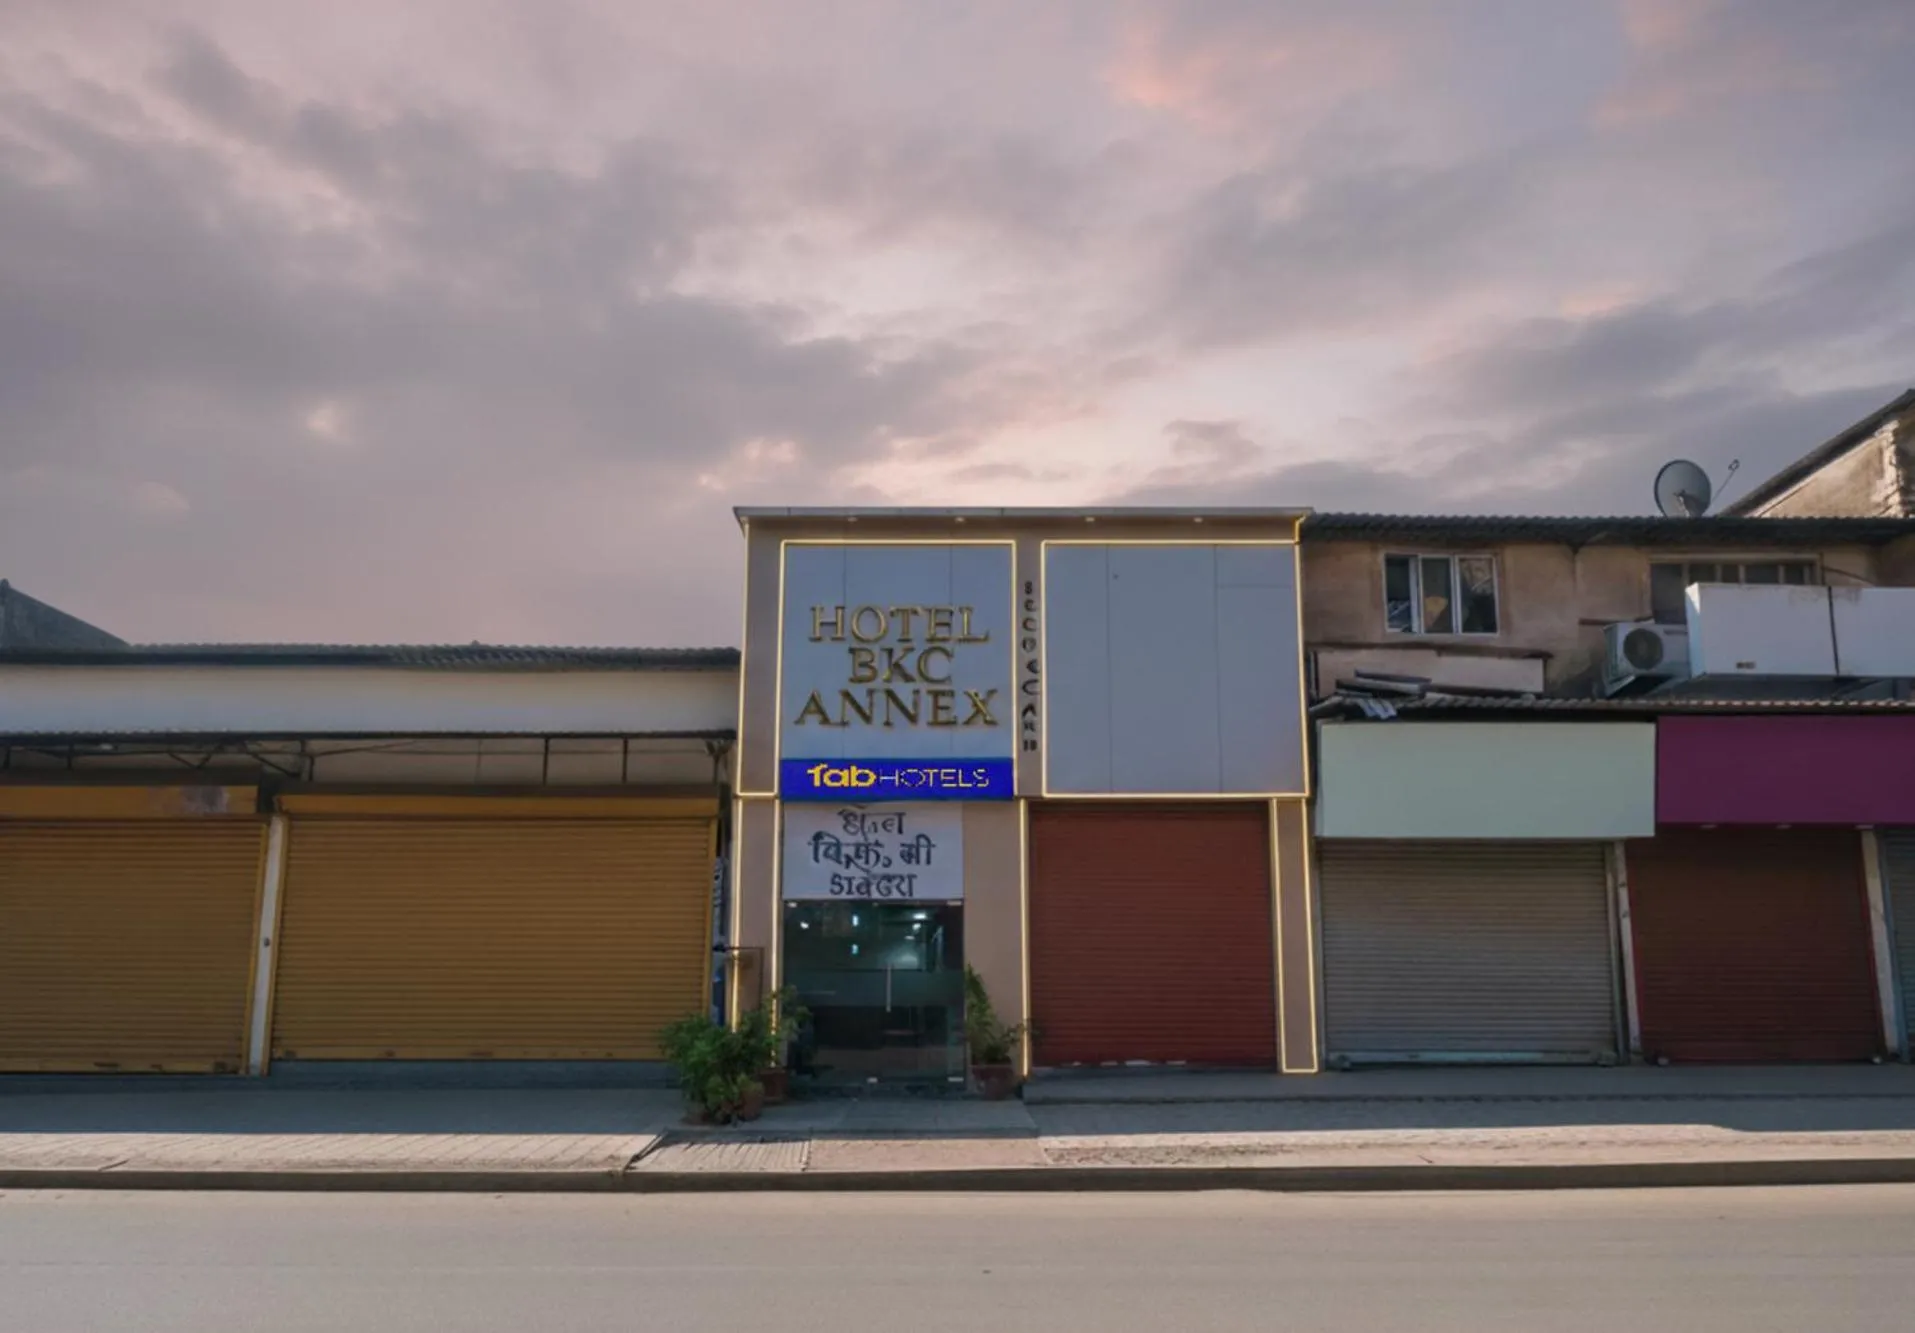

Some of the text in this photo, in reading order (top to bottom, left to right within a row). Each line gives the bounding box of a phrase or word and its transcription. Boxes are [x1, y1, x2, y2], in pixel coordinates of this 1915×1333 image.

[808, 605, 990, 643] HOTEL
[848, 646, 955, 684] BKC
[793, 688, 999, 727] ANNEX
